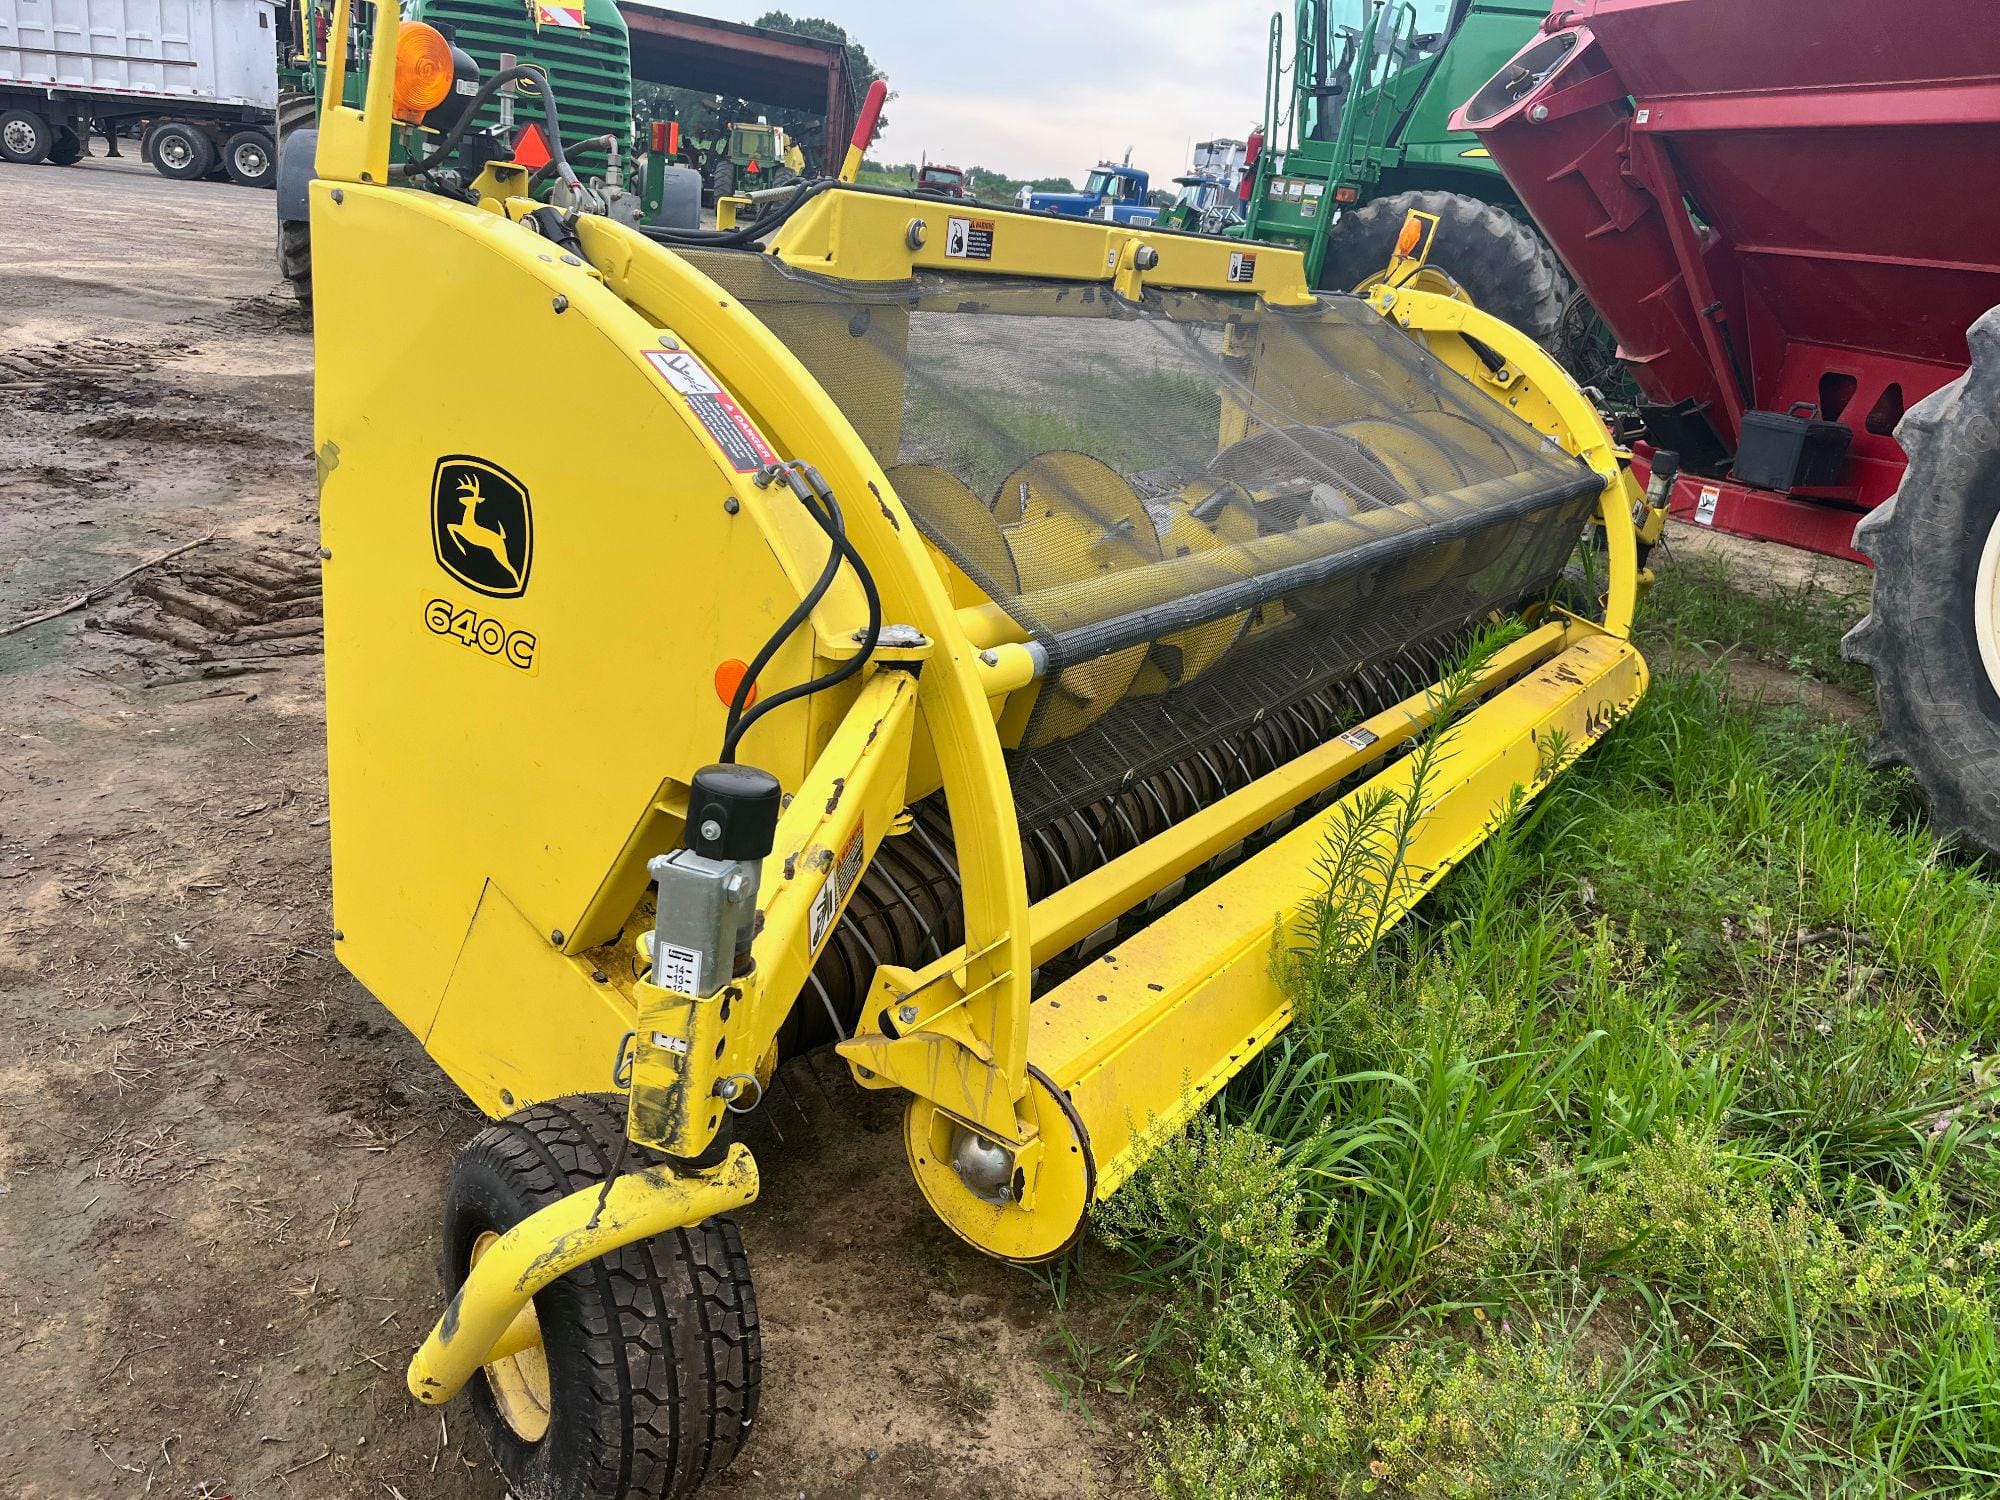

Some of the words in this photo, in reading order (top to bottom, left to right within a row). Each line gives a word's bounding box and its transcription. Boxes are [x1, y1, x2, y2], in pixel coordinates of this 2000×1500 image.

[735, 414, 771, 458] DANGER
[425, 598, 537, 669] 640C
[673, 975, 684, 985] 13
[674, 964, 684, 975] 14
